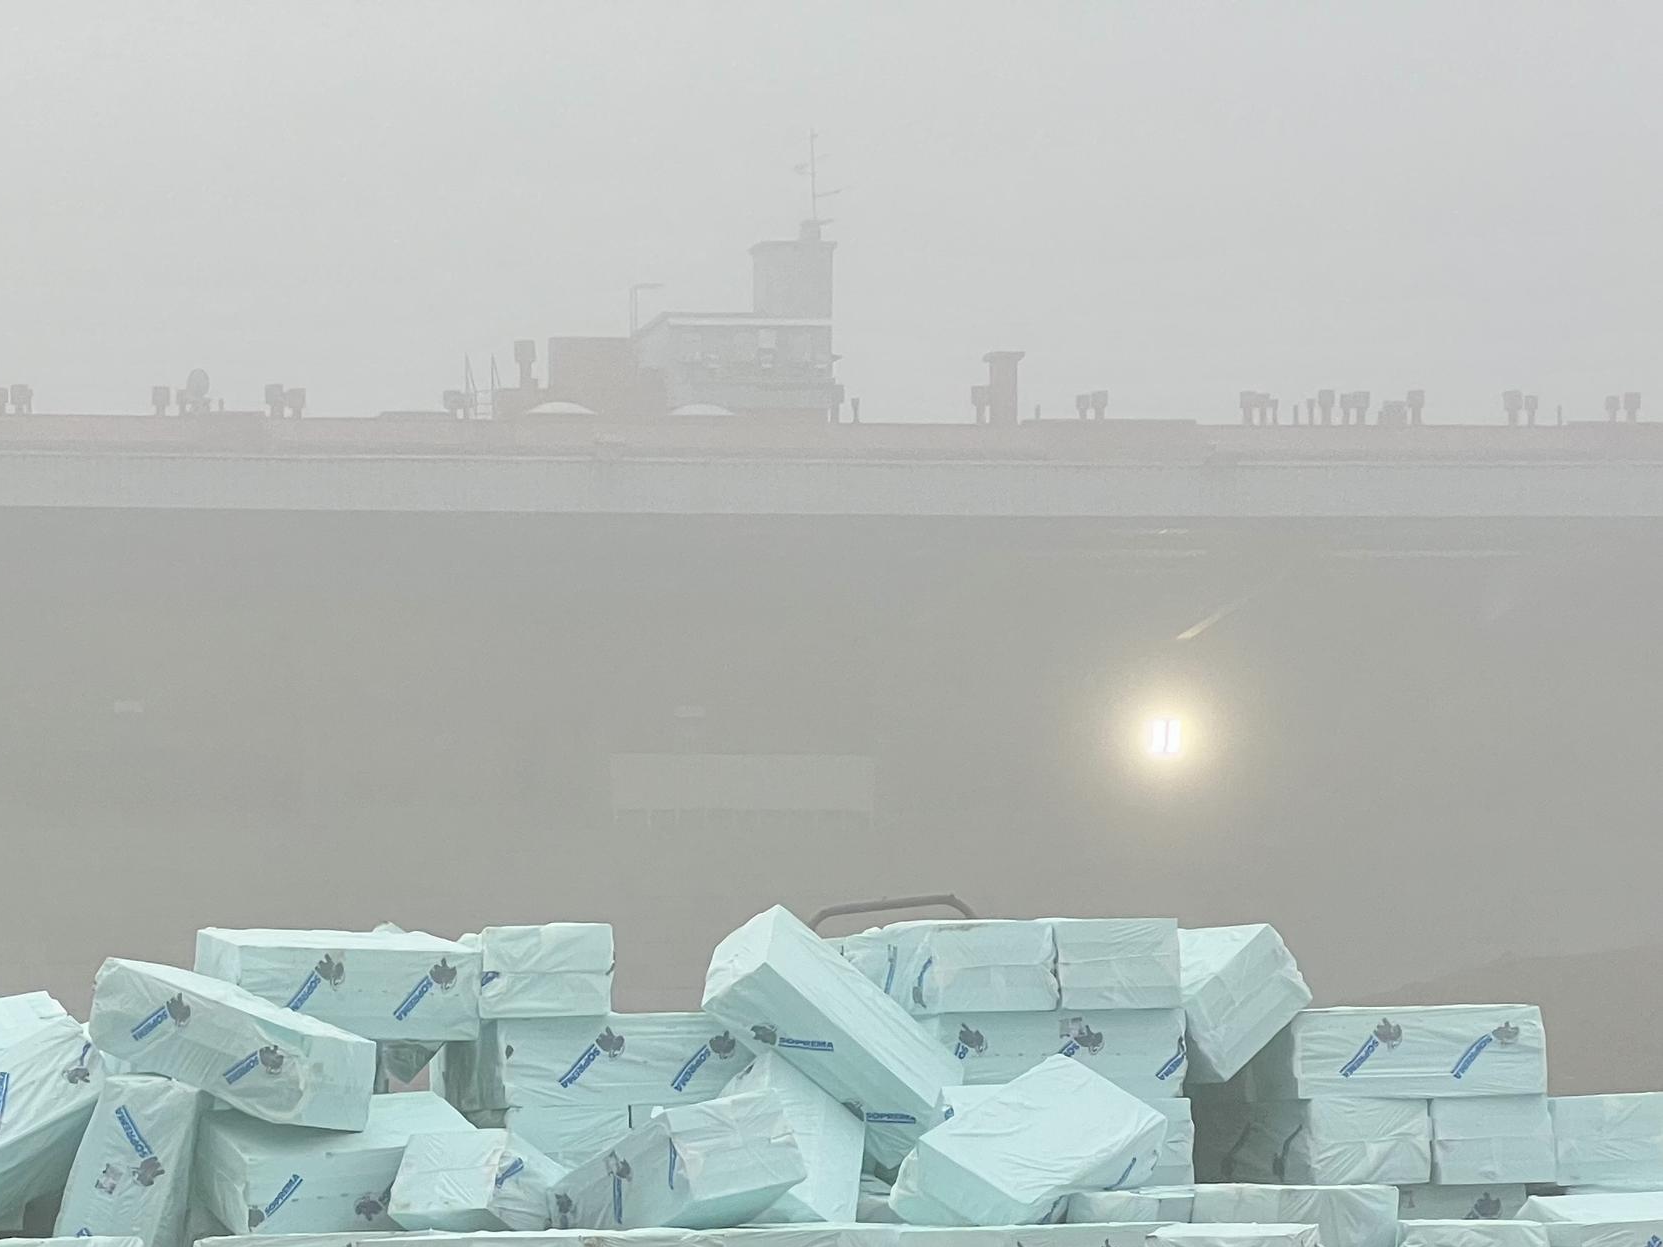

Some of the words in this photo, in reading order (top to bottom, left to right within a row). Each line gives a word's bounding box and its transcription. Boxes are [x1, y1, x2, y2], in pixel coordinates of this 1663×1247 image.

[396, 979, 433, 1021] SOPREMA
[778, 1037, 834, 1049] SOPREMA
[1342, 1038, 1379, 1077] SOPREMA
[1453, 1035, 1492, 1079] SOPREMA
[561, 1048, 600, 1088] SOPREMA
[674, 1048, 711, 1092] SOPREMA
[115, 1106, 148, 1159] SOPREMA
[264, 1174, 300, 1216] SOPREMA
